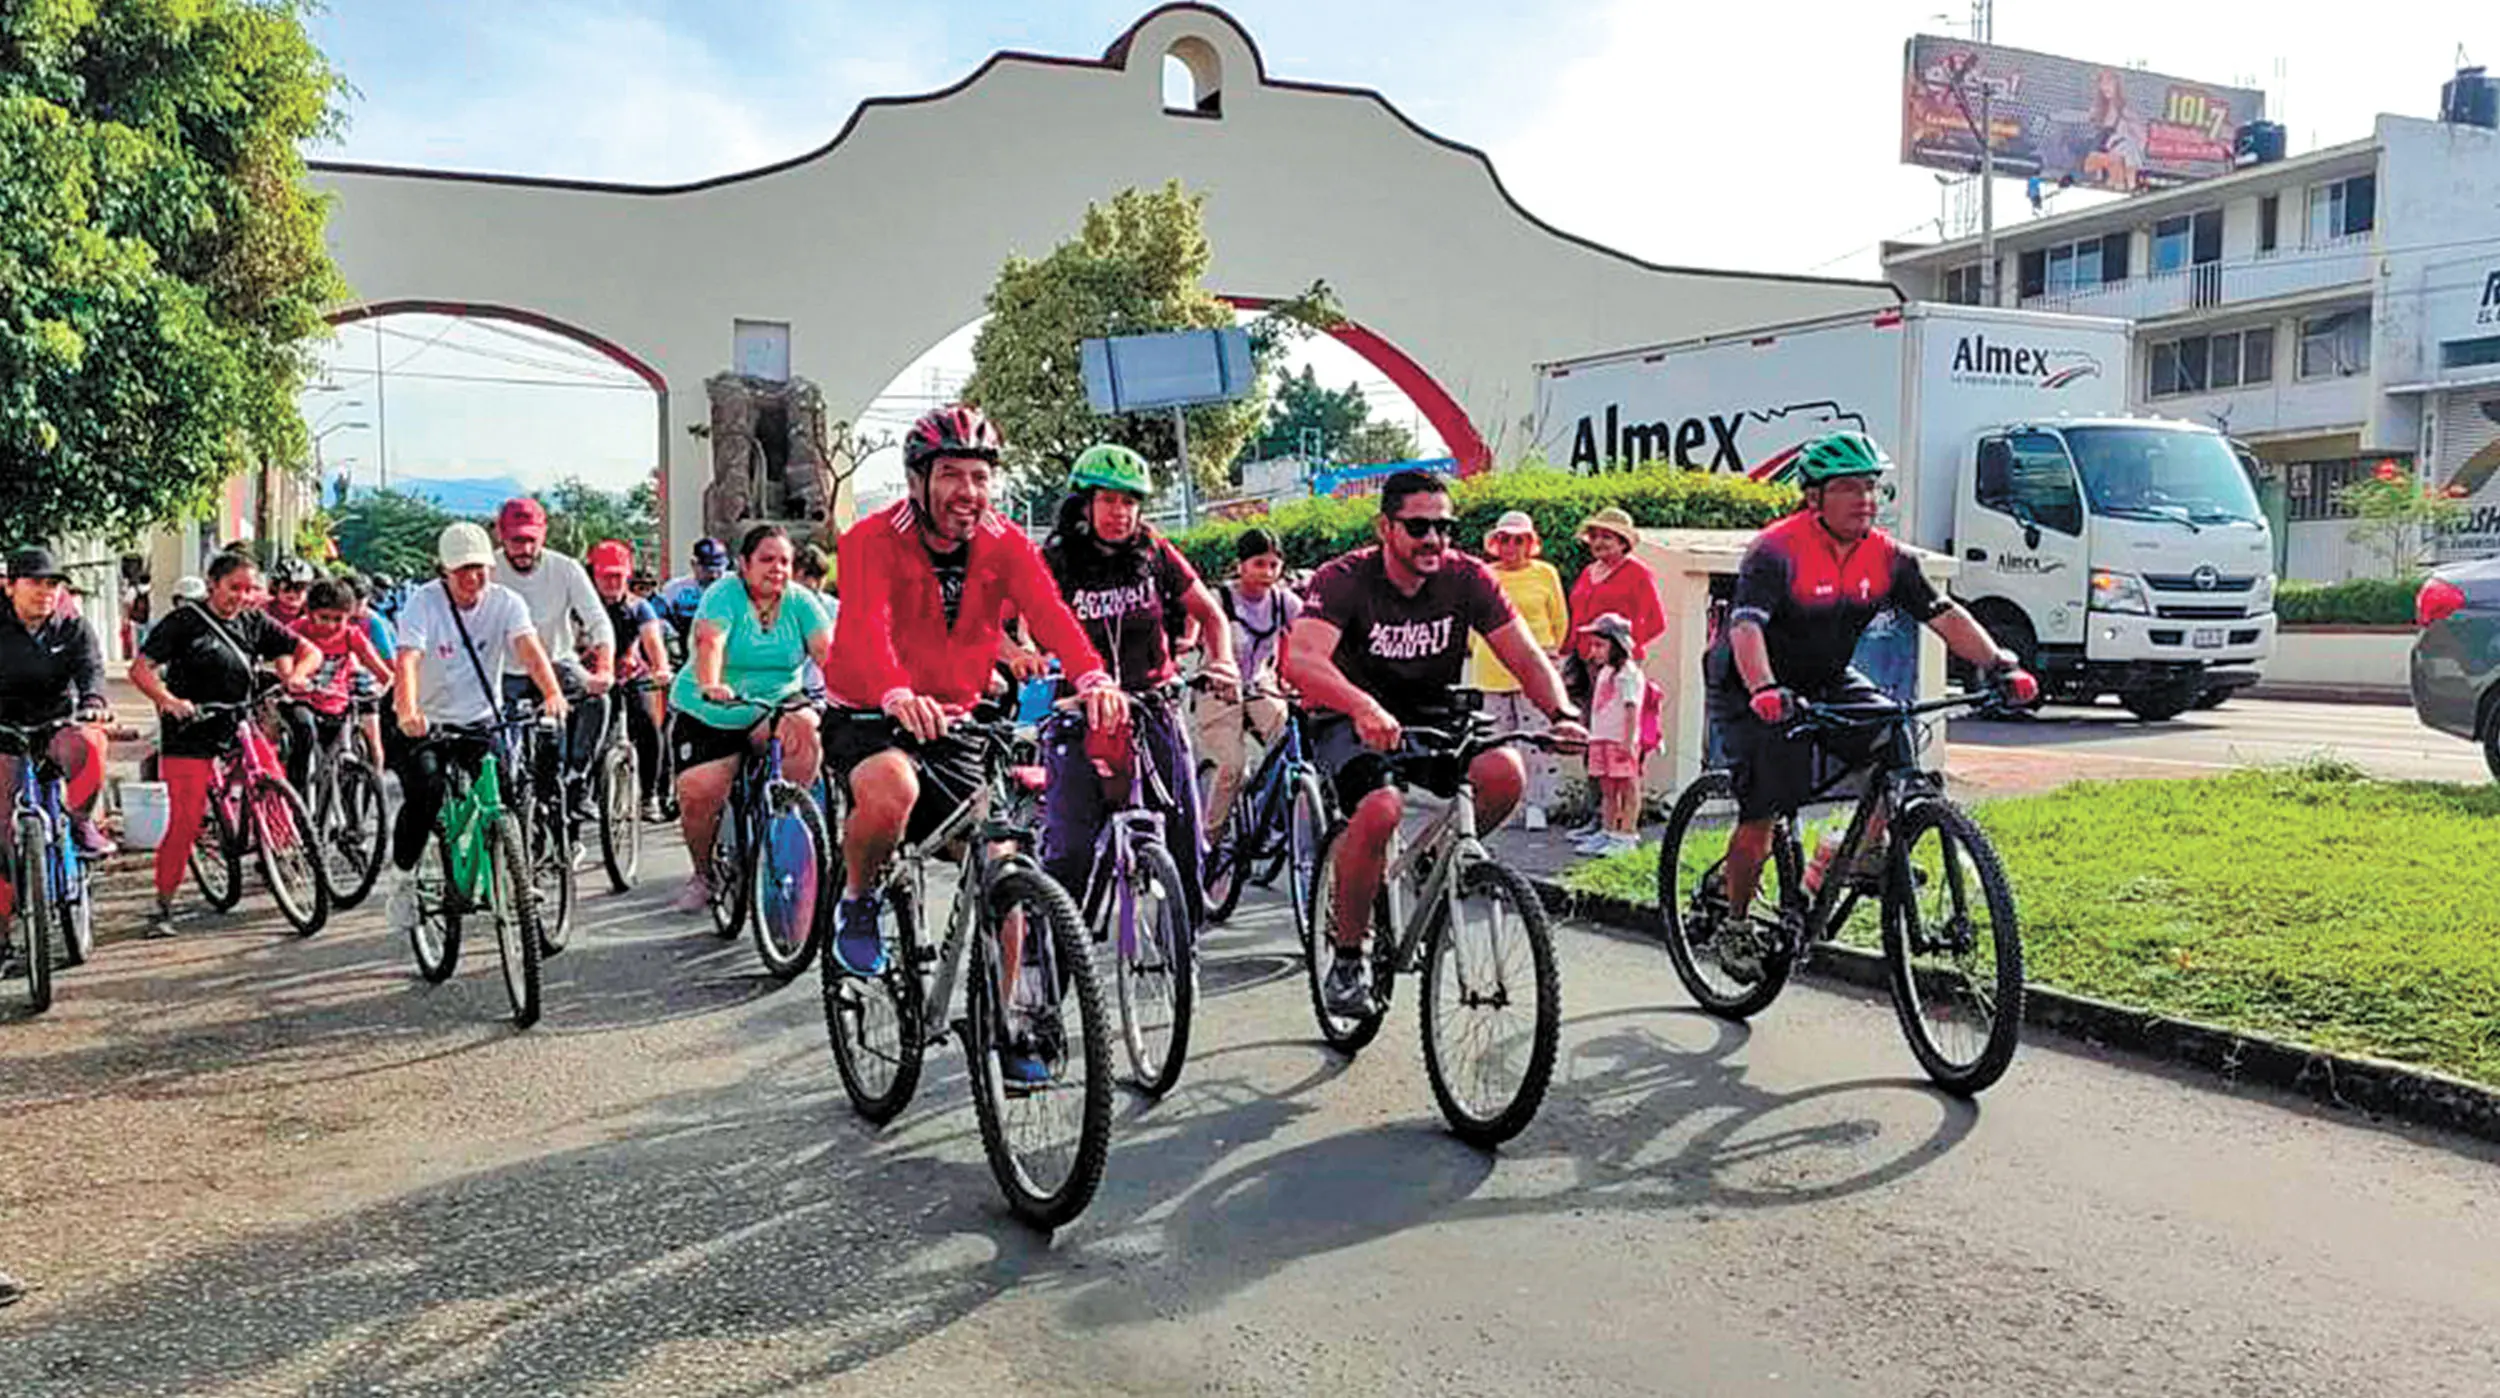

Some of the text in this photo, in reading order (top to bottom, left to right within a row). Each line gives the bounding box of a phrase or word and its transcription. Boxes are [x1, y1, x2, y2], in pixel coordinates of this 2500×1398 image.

[2168, 92, 2227, 139] 101.7
[1952, 334, 2049, 376] Almex
[1569, 404, 1746, 478] Almex
